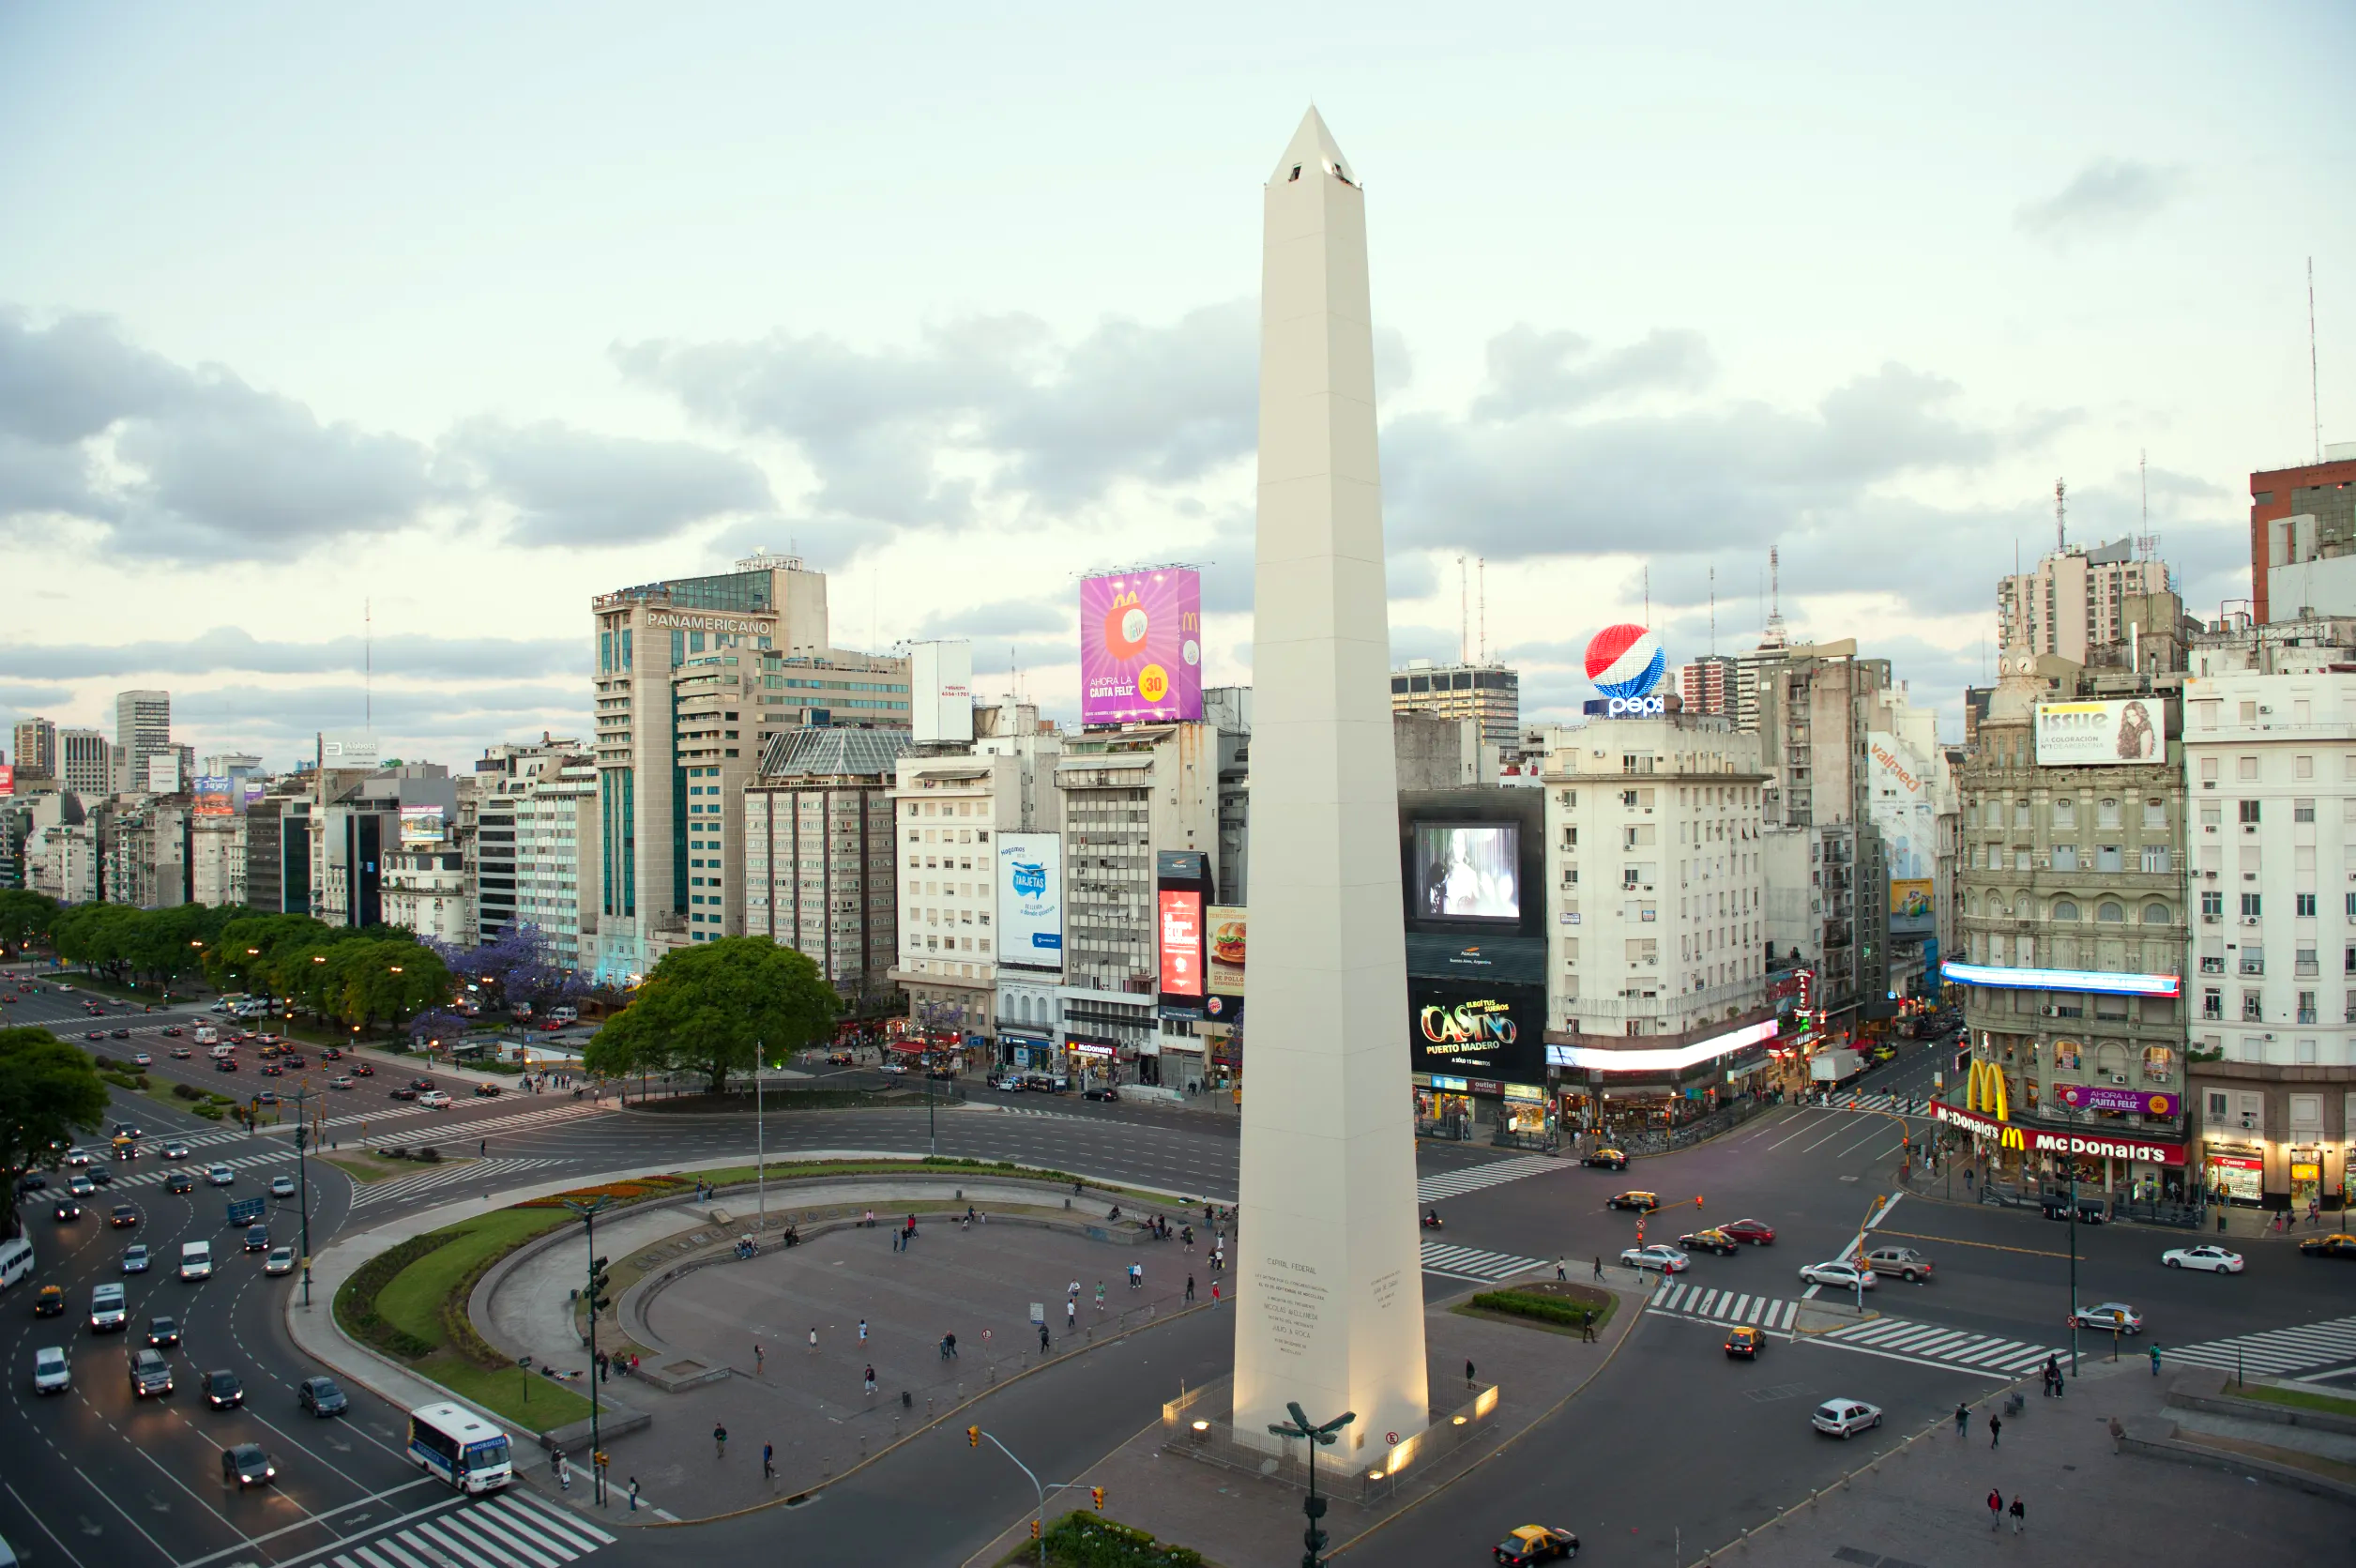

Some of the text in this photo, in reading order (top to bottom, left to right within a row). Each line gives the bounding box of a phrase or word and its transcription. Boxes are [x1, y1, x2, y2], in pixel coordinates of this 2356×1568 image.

[647, 613, 769, 634] PANAMERICANO
[1089, 676, 1132, 686] AHORA LA
[1089, 686, 1133, 698] CAJITA FELIZ
[1608, 693, 1664, 718] pepsi
[2042, 707, 2108, 732] issue
[344, 741, 376, 750] Abbott
[1871, 742, 1922, 793] valmed
[1000, 846, 1026, 856] Hagamos
[1015, 875, 1044, 889] TARJETAS
[1466, 998, 1483, 1009] ELEGÍ
[1484, 1003, 1510, 1012] SUEÑOS
[1421, 1004, 1517, 1044] CASINO
[1078, 1043, 1113, 1055] McDonald's
[1426, 1041, 1500, 1055] PUERTO MADERO
[2090, 1090, 2121, 1099] AHORA
[2090, 1097, 2137, 1109] CAJITA FELIZ
[1937, 1106, 1999, 1139] McDonald's
[2035, 1134, 2166, 1162] McDonald's
[2222, 1158, 2246, 1166] Canon
[1267, 1257, 1316, 1275] CAPITAL FEDERAL
[1294, 1330, 1311, 1339] ROCA
[471, 1439, 506, 1452] NORDELTA
